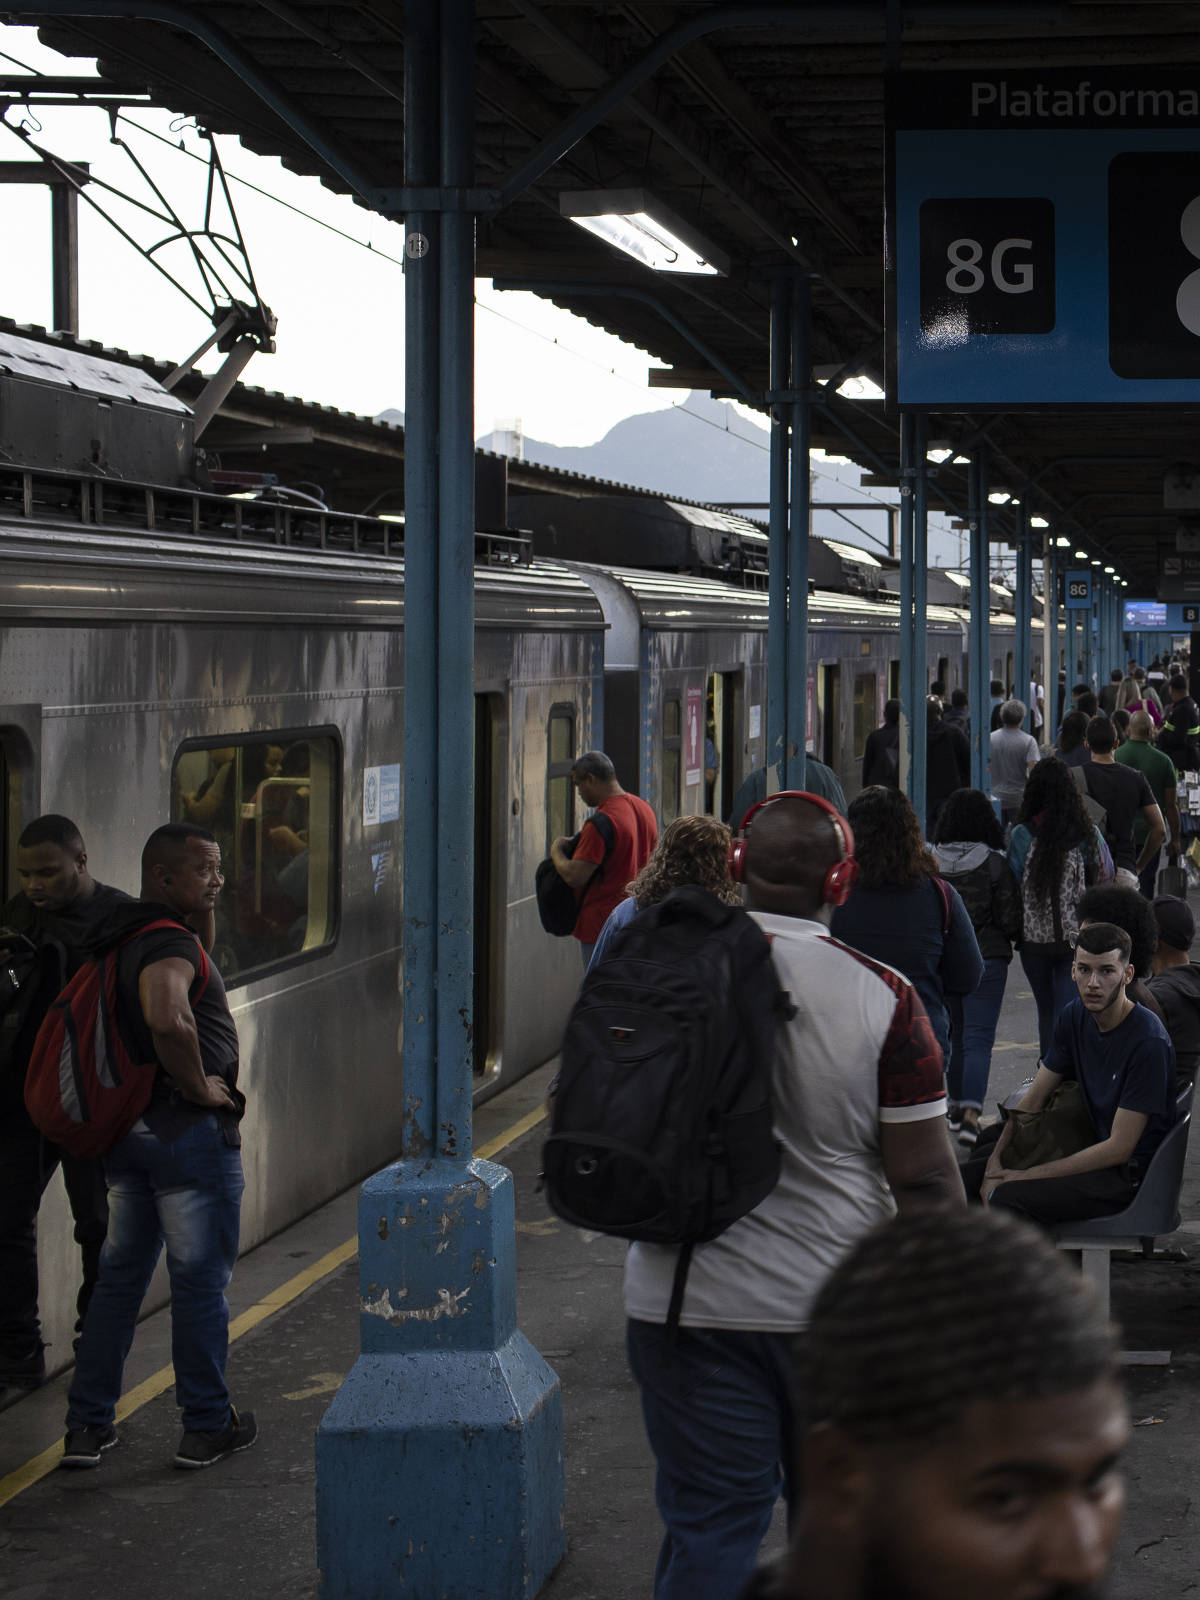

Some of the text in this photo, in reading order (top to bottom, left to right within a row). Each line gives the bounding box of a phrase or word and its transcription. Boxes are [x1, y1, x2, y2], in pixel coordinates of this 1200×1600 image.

[971, 82, 1198, 116] Plataforma
[945, 238, 1034, 294] 8G
[1070, 584, 1087, 596] 8G
[1186, 609, 1195, 620] 8
